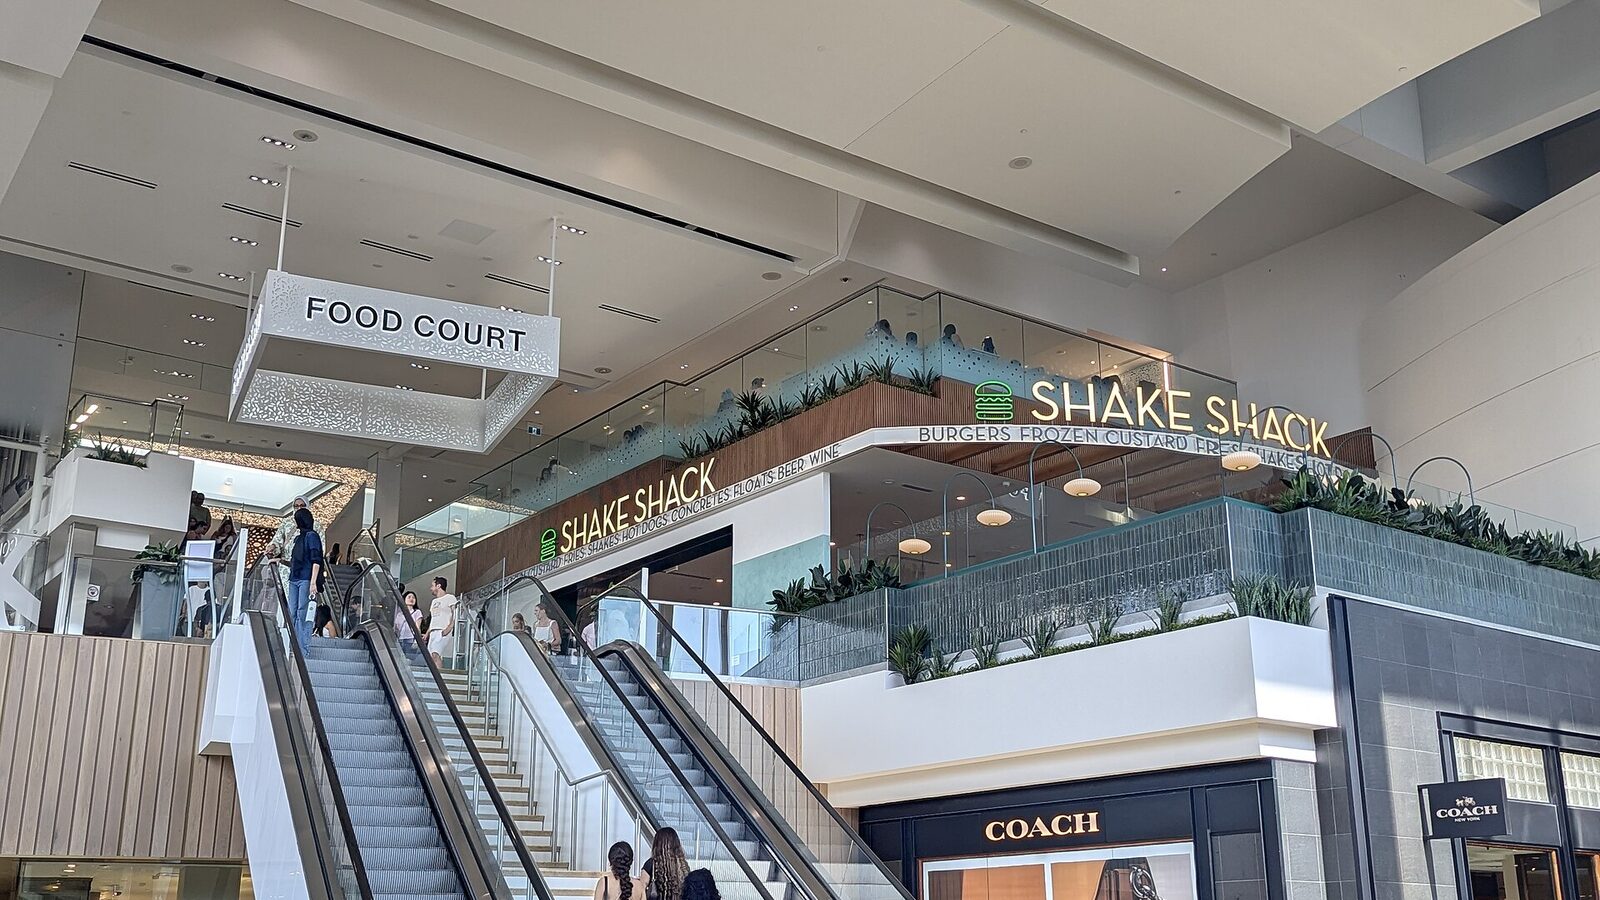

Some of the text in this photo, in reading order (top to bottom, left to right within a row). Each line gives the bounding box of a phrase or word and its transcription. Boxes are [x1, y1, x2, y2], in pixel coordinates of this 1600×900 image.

[306, 296, 527, 351] FOOD COURT
[919, 426, 1011, 442] BURGERS
[1020, 427, 1099, 443] FROZEN
[1105, 429, 1188, 451] CUSTARD
[1031, 380, 1331, 458] SHAKE SHACK
[560, 457, 716, 553] SHAKE SHACK
[587, 535, 620, 556] SHAKES
[622, 524, 640, 541] HOT
[641, 513, 668, 534] DOGS
[671, 488, 730, 522] CONCRETES
[733, 470, 775, 497] FLOATS
[777, 458, 805, 481] BEER
[809, 443, 841, 465] WINE
[985, 811, 1100, 841] COACH
[1436, 805, 1498, 818] COACH
